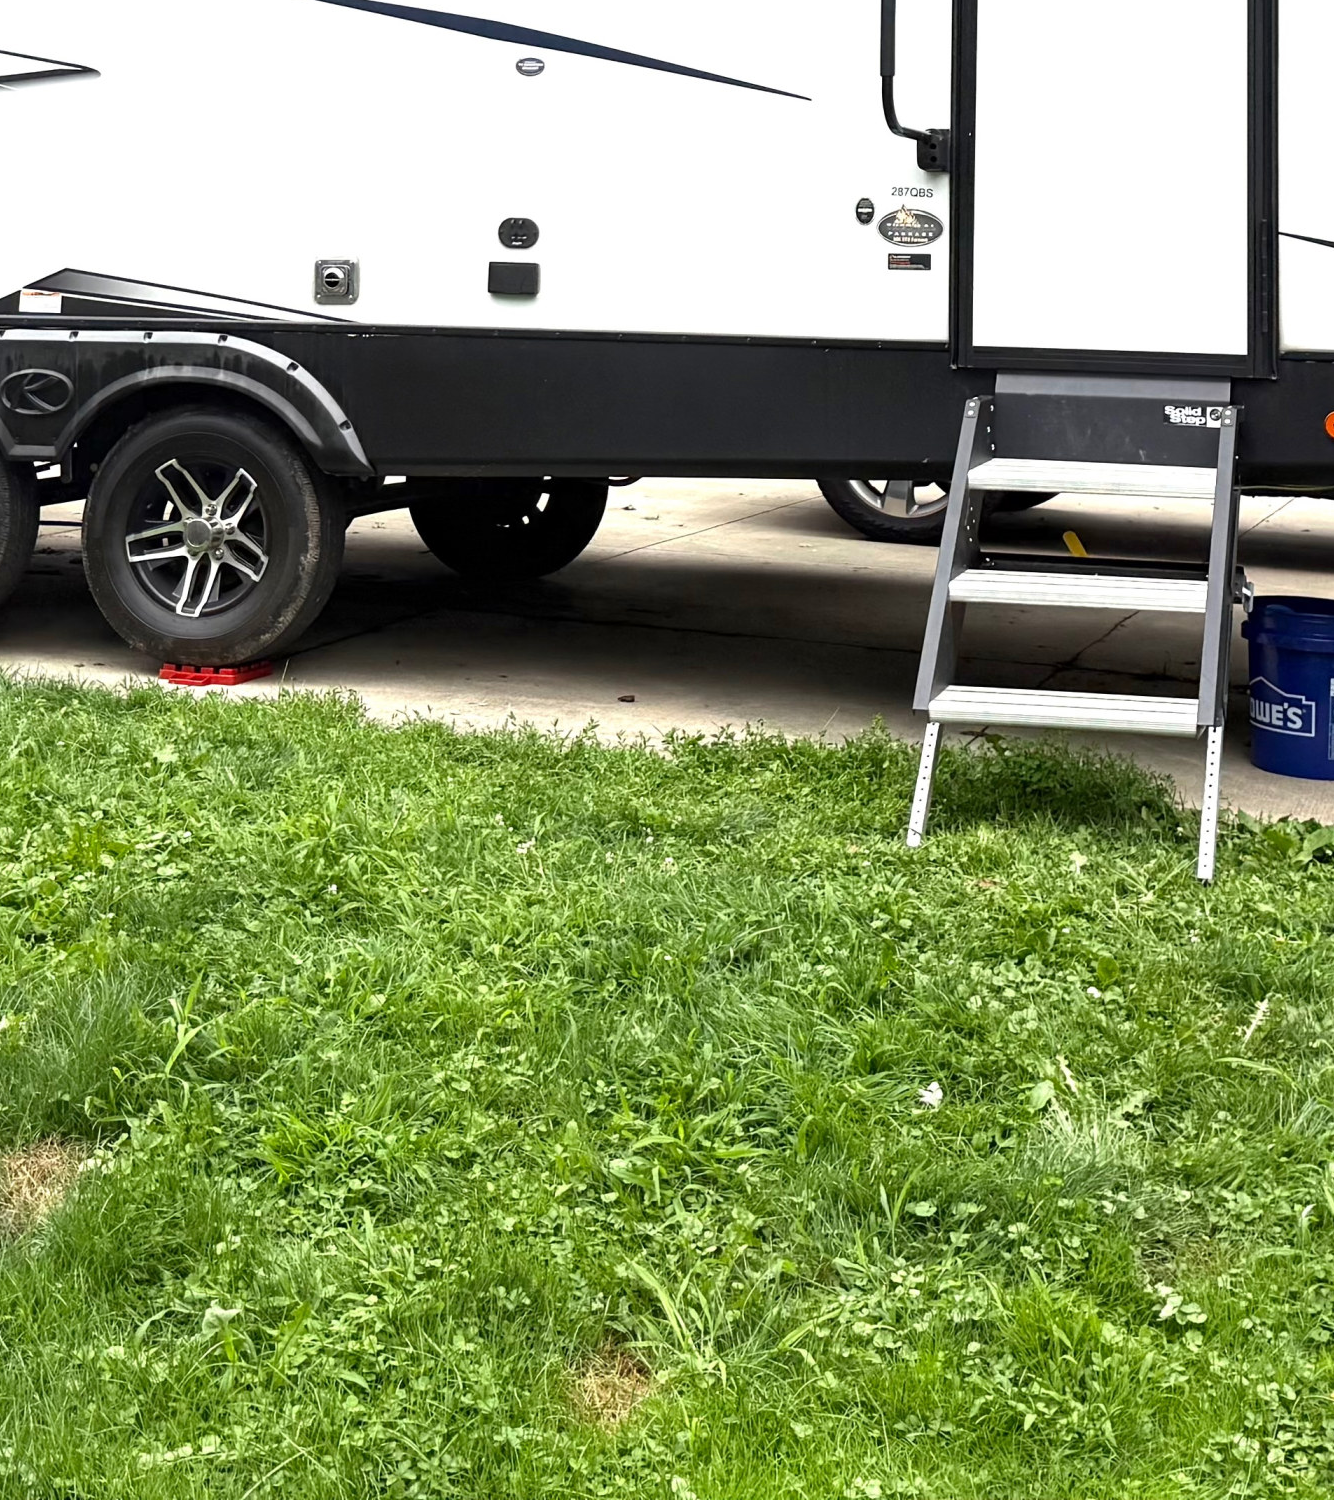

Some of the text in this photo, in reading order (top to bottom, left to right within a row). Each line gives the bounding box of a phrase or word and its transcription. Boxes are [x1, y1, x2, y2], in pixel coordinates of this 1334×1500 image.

[891, 186, 934, 199] 287QBS
[1164, 405, 1202, 417] Solid
[1169, 414, 1207, 427] Step
[1250, 697, 1303, 730] OWE'S
